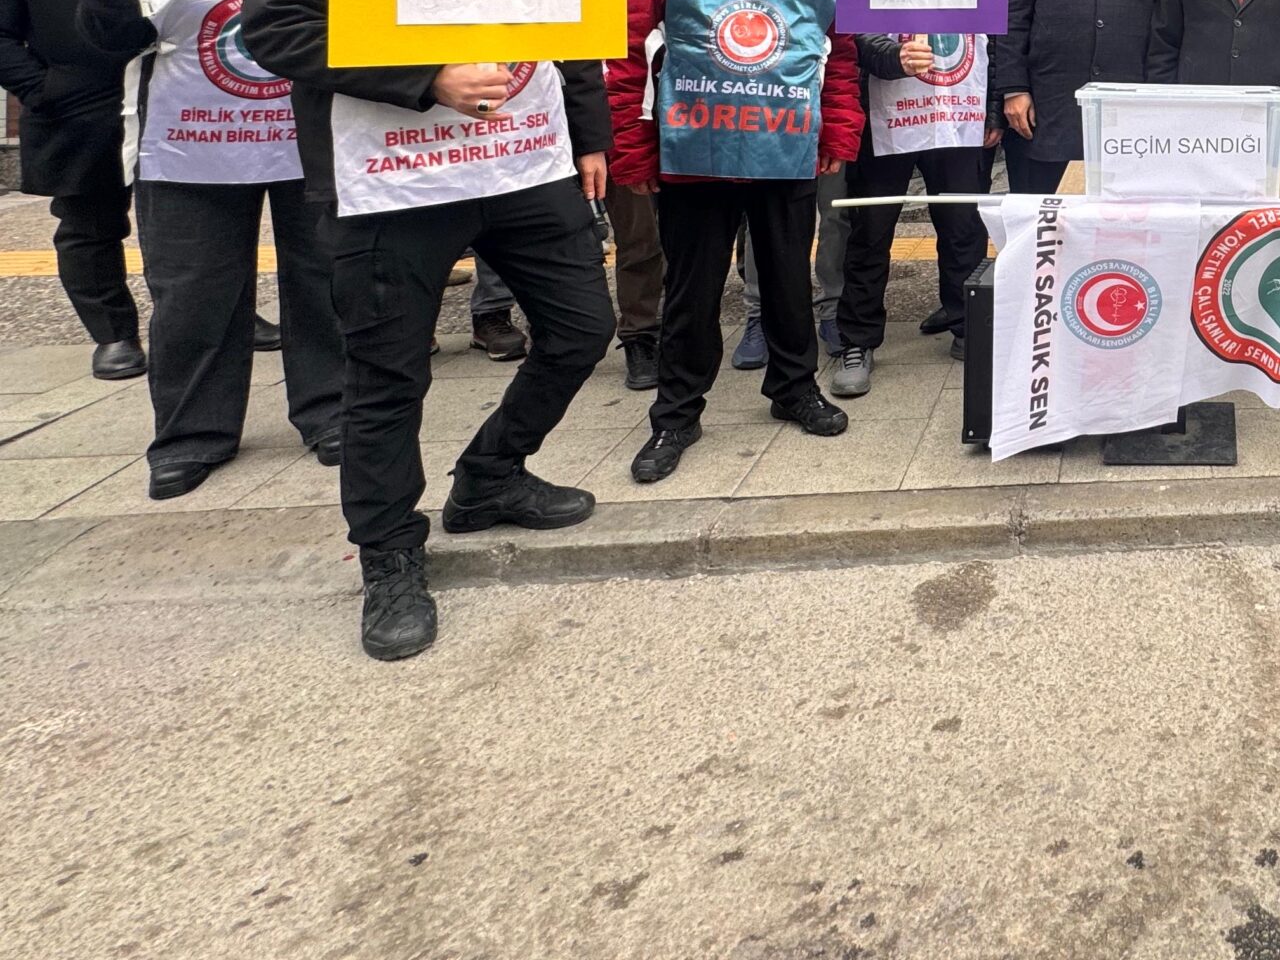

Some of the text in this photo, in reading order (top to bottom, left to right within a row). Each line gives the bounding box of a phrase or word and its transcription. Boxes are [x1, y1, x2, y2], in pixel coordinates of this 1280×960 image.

[675, 75, 811, 100] BİRLİK SAĞLIK SEN
[180, 107, 296, 123] BİRLİK YEREL
[896, 95, 934, 111] BİRLİK
[666, 97, 812, 135] GÖREVLİ
[887, 114, 928, 129] ZAMAN
[167, 128, 223, 141] ZAMAN
[227, 126, 283, 143] BİRLİK
[385, 111, 549, 147] BİRLİK YEREL-SEN
[366, 151, 443, 174] ZAMAN
[449, 139, 511, 164] BİRLİK
[1103, 133, 1261, 158] GEÇİM SANDIĞI
[1029, 197, 1064, 431] BİRLİK SAĞLIK SEN
